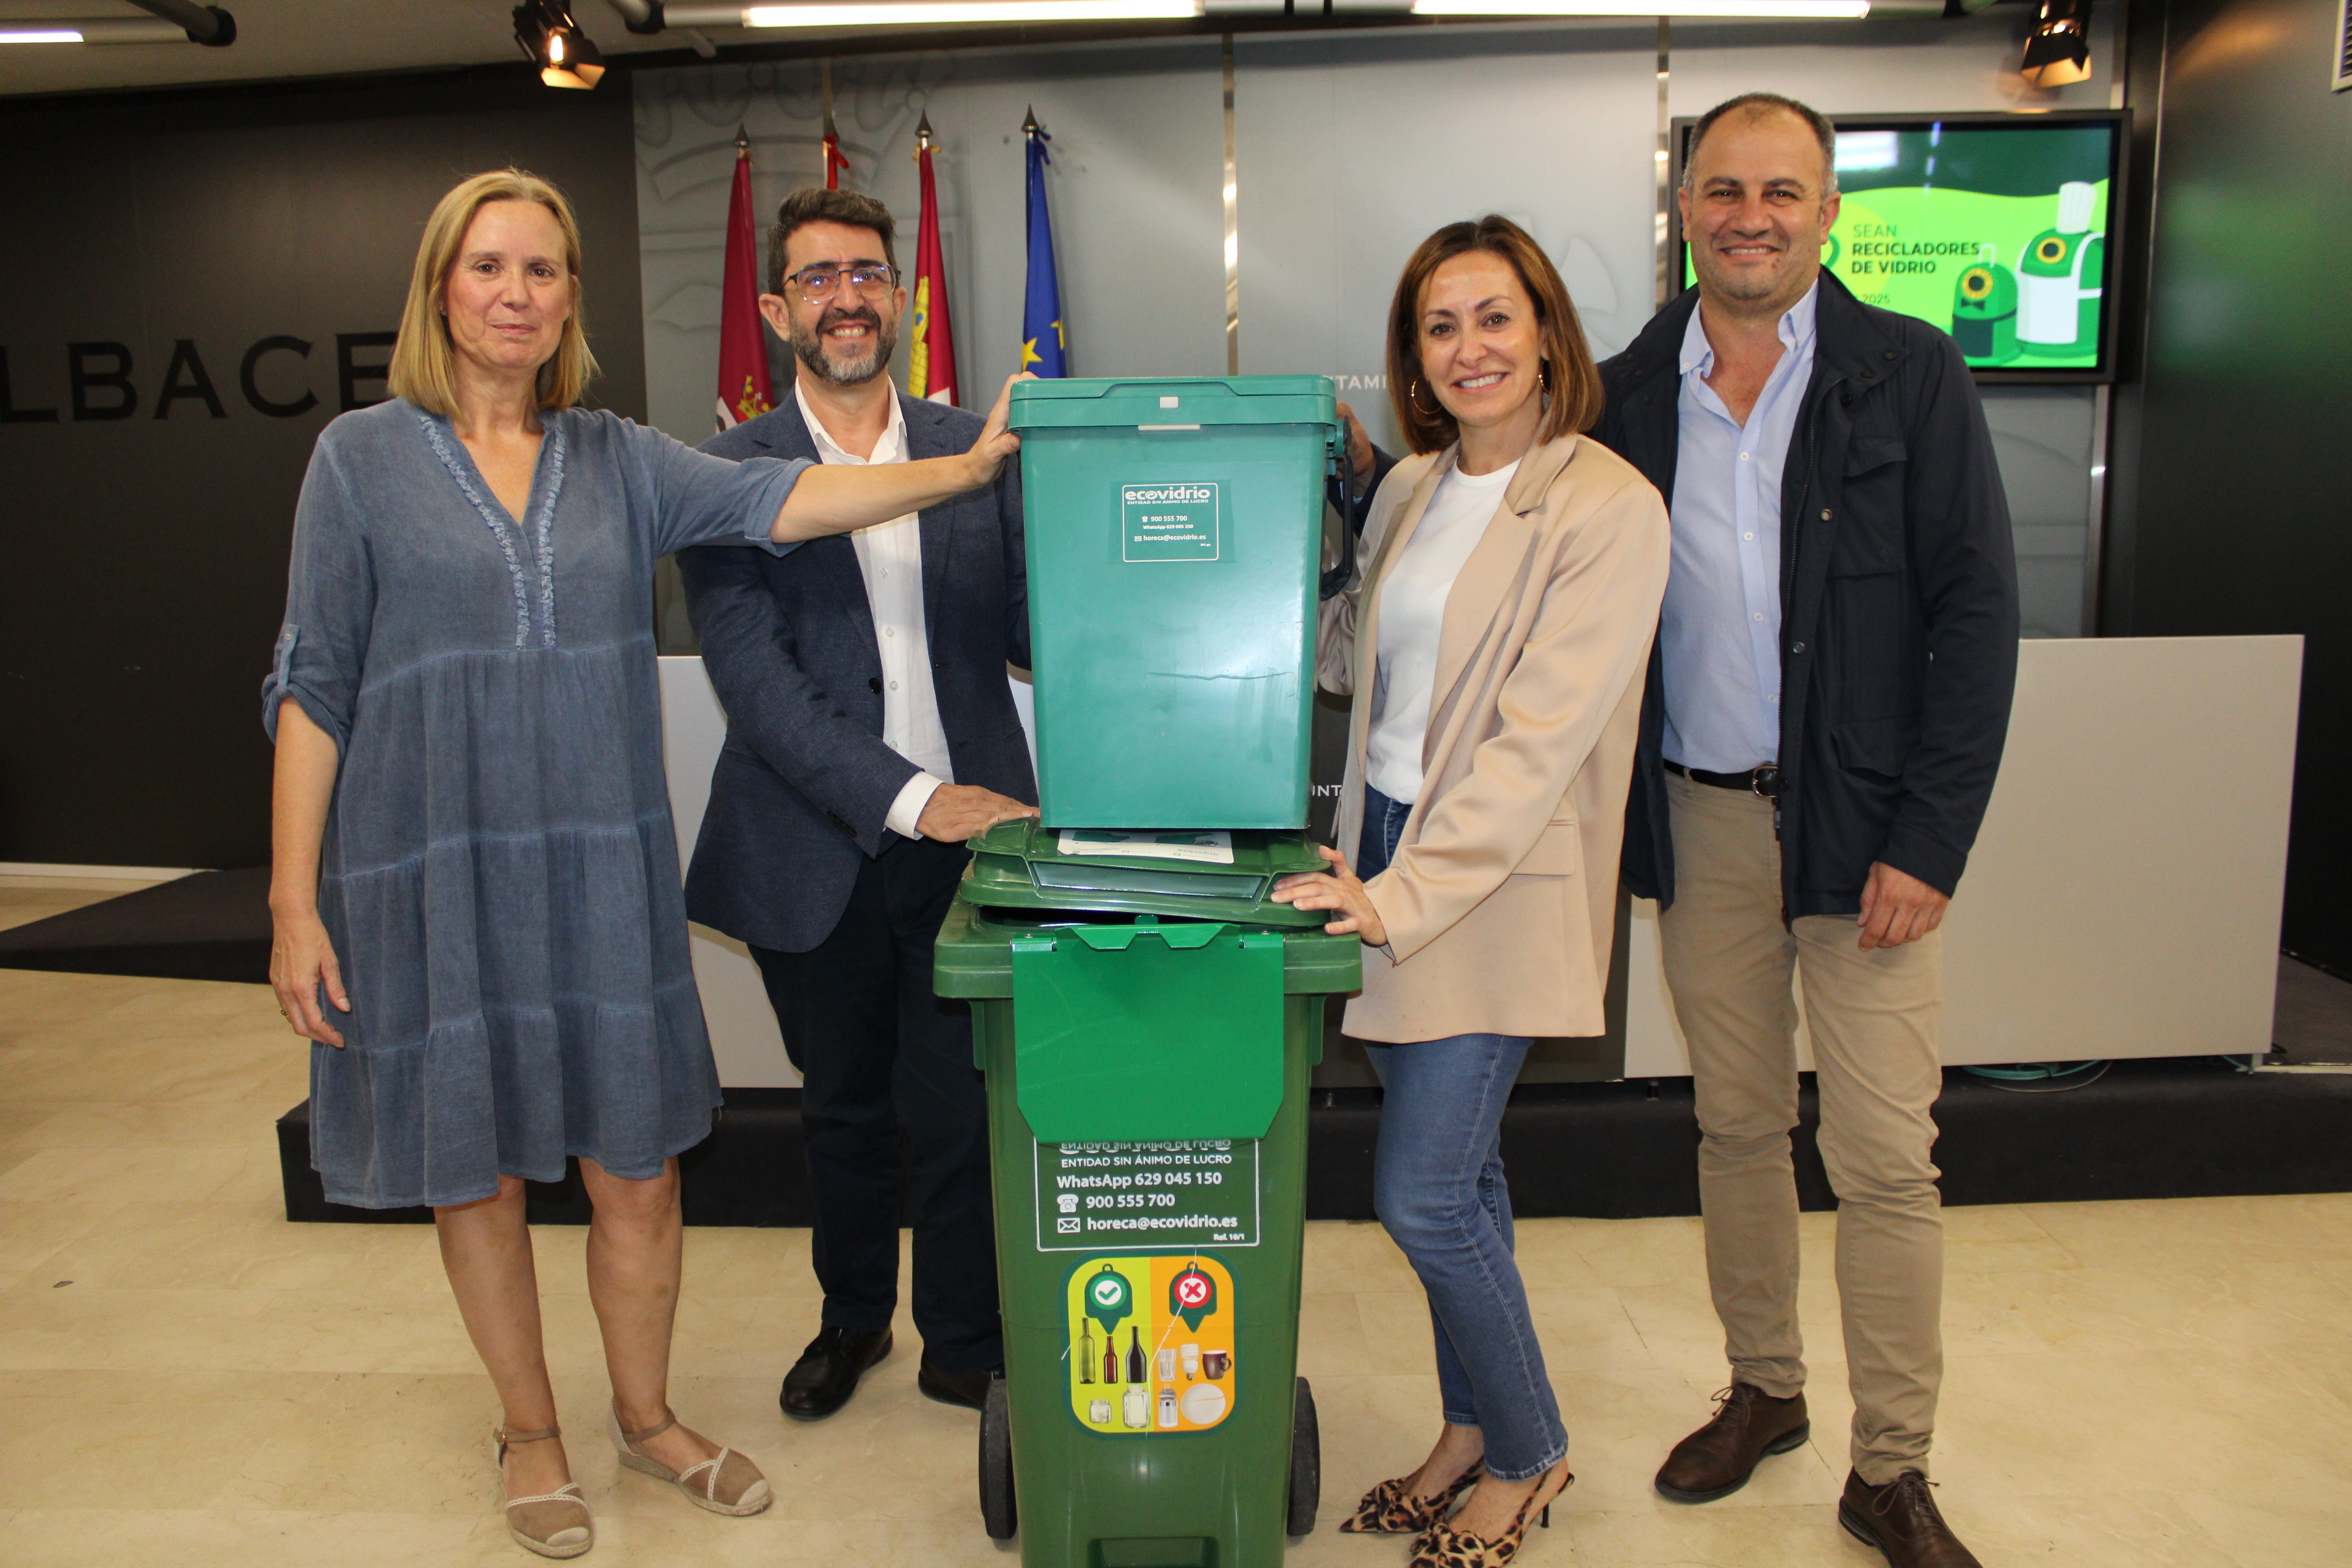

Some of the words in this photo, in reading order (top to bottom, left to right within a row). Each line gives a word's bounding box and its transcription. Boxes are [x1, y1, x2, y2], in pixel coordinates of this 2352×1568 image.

[1853, 224, 1897, 238] SEAN
[1853, 242, 1980, 256] RECICLADORES
[1852, 261, 1874, 274] DE
[1879, 261, 1936, 274] VIDRIO
[1863, 294, 1891, 304] 2025
[1125, 486, 1211, 500] ecovidrio
[1061, 1157, 1111, 1168] ENTIDAD
[1114, 1157, 1131, 1166] SIN
[1134, 1154, 1172, 1165] ÁNIMO
[1175, 1155, 1191, 1164] DE
[1193, 1155, 1232, 1164] LUCRO
[1057, 1174, 1132, 1189] WhatsApp
[1135, 1173, 1161, 1185] 629
[1165, 1173, 1191, 1185] 045
[1196, 1172, 1222, 1184] 150
[1086, 1196, 1113, 1209] 900
[1118, 1195, 1144, 1207] 555
[1148, 1194, 1175, 1207] 700
[1087, 1215, 1238, 1230] horeca@ecovidrio.es
